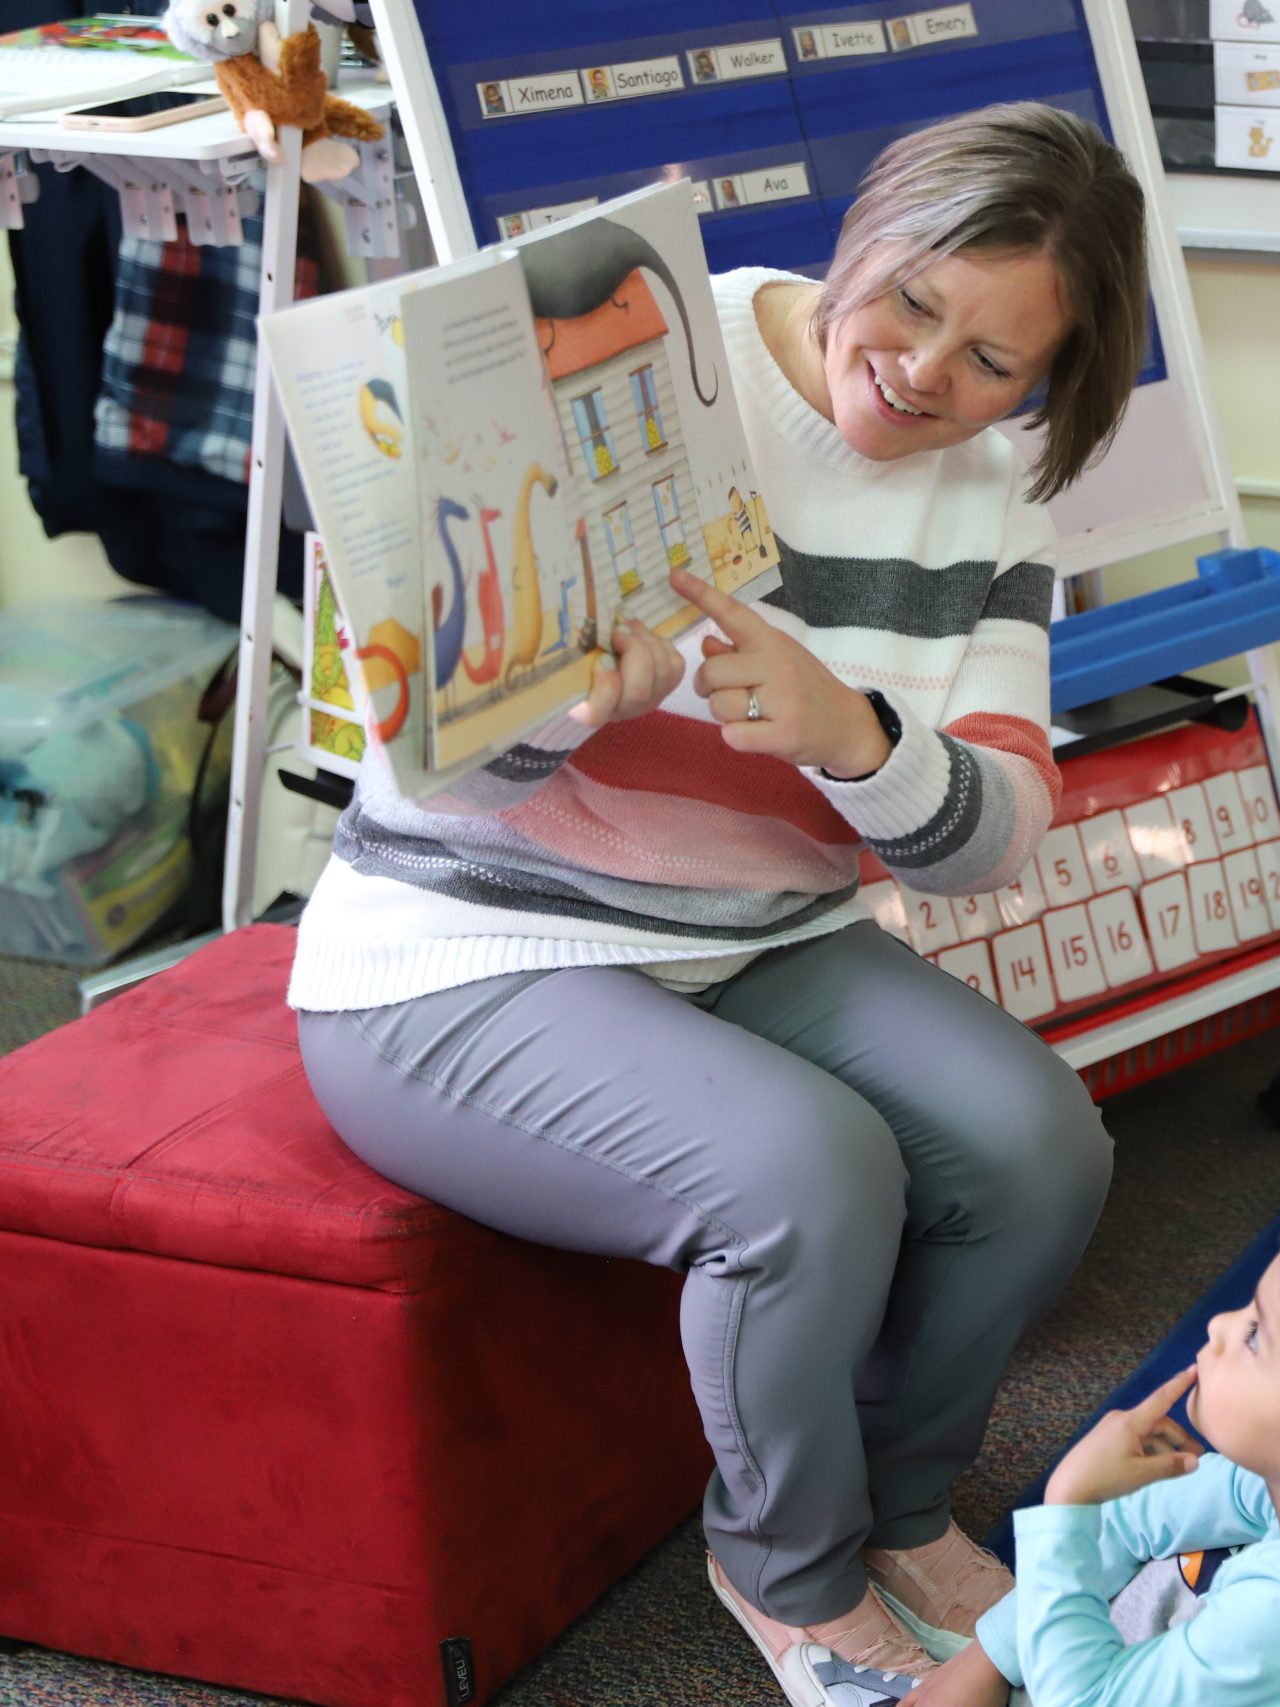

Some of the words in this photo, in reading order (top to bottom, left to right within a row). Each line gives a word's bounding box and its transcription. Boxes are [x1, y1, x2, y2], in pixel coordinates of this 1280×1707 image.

[925, 17, 967, 36] Emery
[831, 33, 875, 49] Ivette
[729, 51, 775, 69] Walker
[616, 68, 679, 90] Santiago
[519, 84, 574, 104] Ximena
[763, 177, 789, 192] Ava
[919, 901, 936, 929] 2
[1053, 858, 1072, 887] 5
[1103, 846, 1121, 873] 6
[1182, 819, 1197, 845] 8
[1216, 805, 1235, 837] 9
[1011, 957, 1037, 992] 14
[1060, 935, 1088, 970] 15
[1107, 921, 1133, 954] 16
[1158, 904, 1180, 939] 17
[1204, 891, 1227, 921] 18
[1240, 878, 1266, 909] 19
